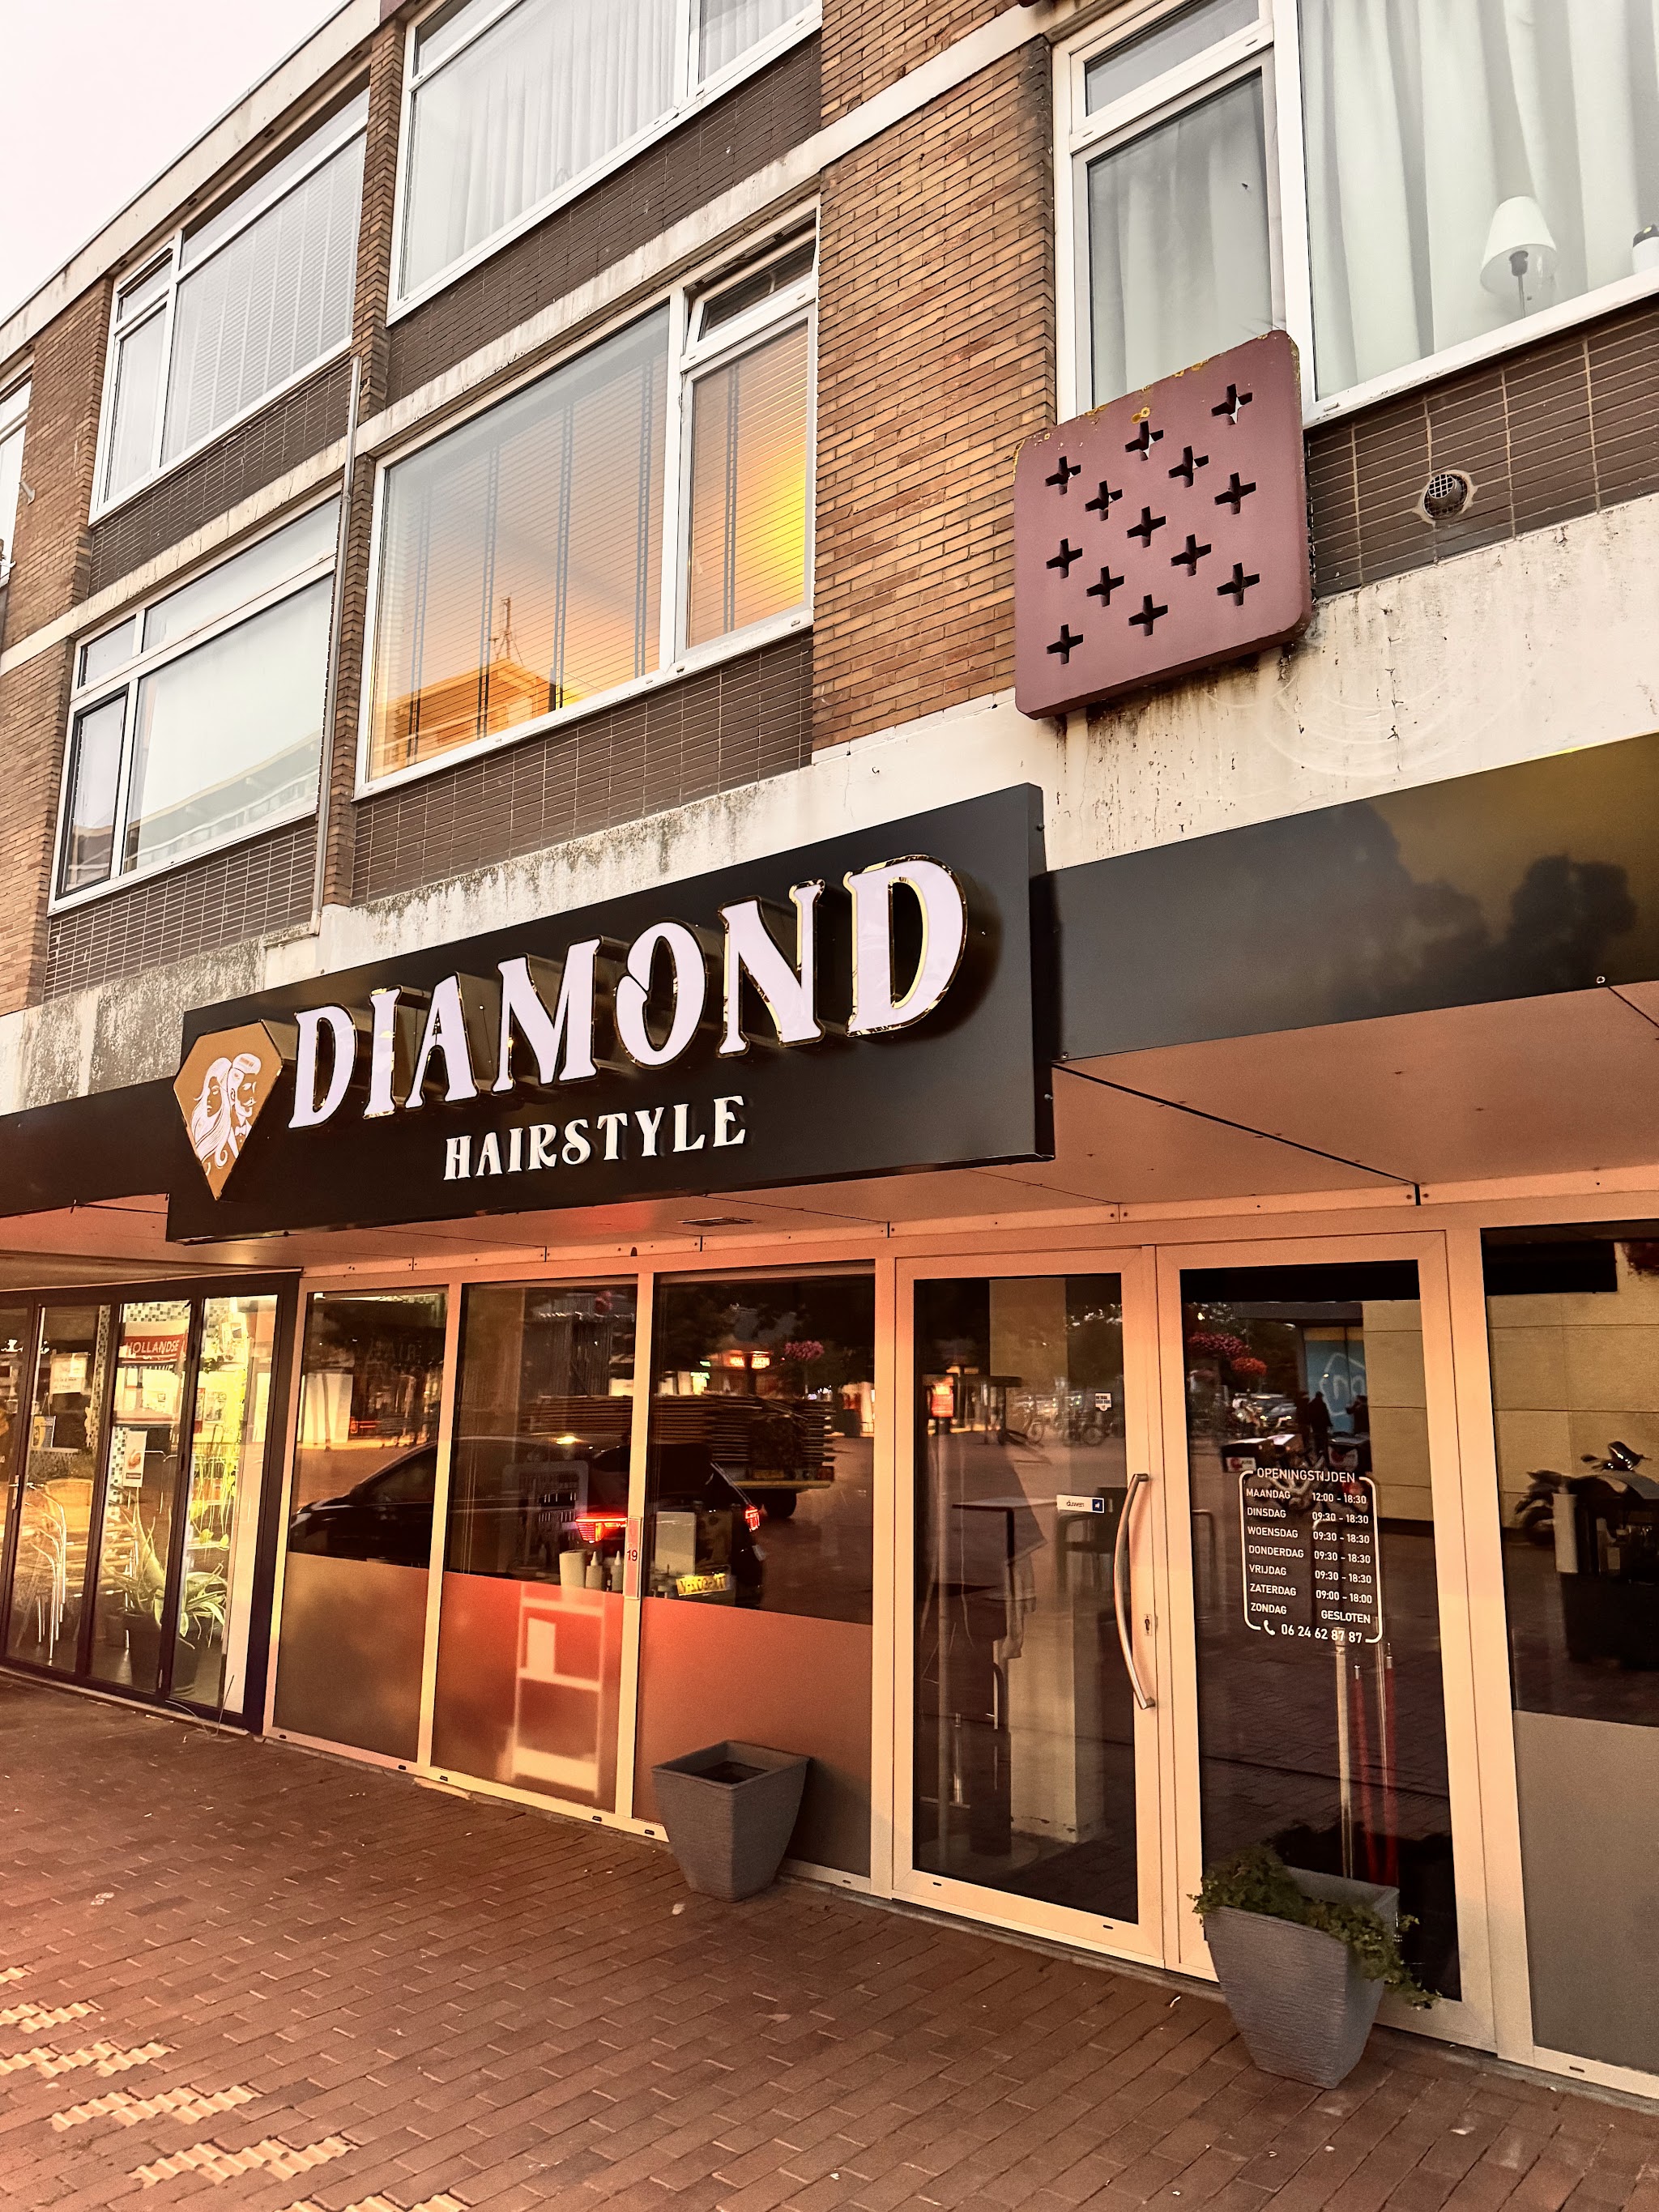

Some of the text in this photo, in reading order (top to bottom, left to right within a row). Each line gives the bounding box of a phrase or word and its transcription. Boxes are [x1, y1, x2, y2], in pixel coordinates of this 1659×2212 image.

[288, 855, 969, 1129] DIAMOND
[443, 1095, 746, 1181] HAIRSTYLE
[126, 1340, 180, 1354] HOLLANDSE
[1256, 1468, 1356, 1484] OPENINGSTIJDEN
[1246, 1488, 1291, 1500] MAANDAG
[1311, 1492, 1334, 1502] 12:00
[1343, 1493, 1367, 1504] 18:30
[1247, 1507, 1287, 1519] DINSDAG
[1311, 1511, 1337, 1522] 09:30
[1346, 1514, 1369, 1524] 18:30
[1247, 1526, 1299, 1538] WOENSDAG
[1313, 1531, 1337, 1541] 09:30
[1346, 1533, 1370, 1544] 18:30
[626, 1549, 638, 1562] 19
[1248, 1545, 1304, 1558] DONDERDAG
[1314, 1550, 1338, 1562] 09:30
[1348, 1553, 1371, 1564] 18:30
[1248, 1564, 1287, 1576] VRIJDAG
[1315, 1570, 1339, 1581] 09:30
[1348, 1573, 1372, 1584] 18:30
[1250, 1583, 1297, 1596] ZATERDAG
[1316, 1589, 1340, 1601] 09:00
[1349, 1592, 1373, 1605] 18:00
[1250, 1602, 1371, 1625] ZONDAG GESLOTEN
[1281, 1623, 1363, 1643] 06 24 62 87 87
